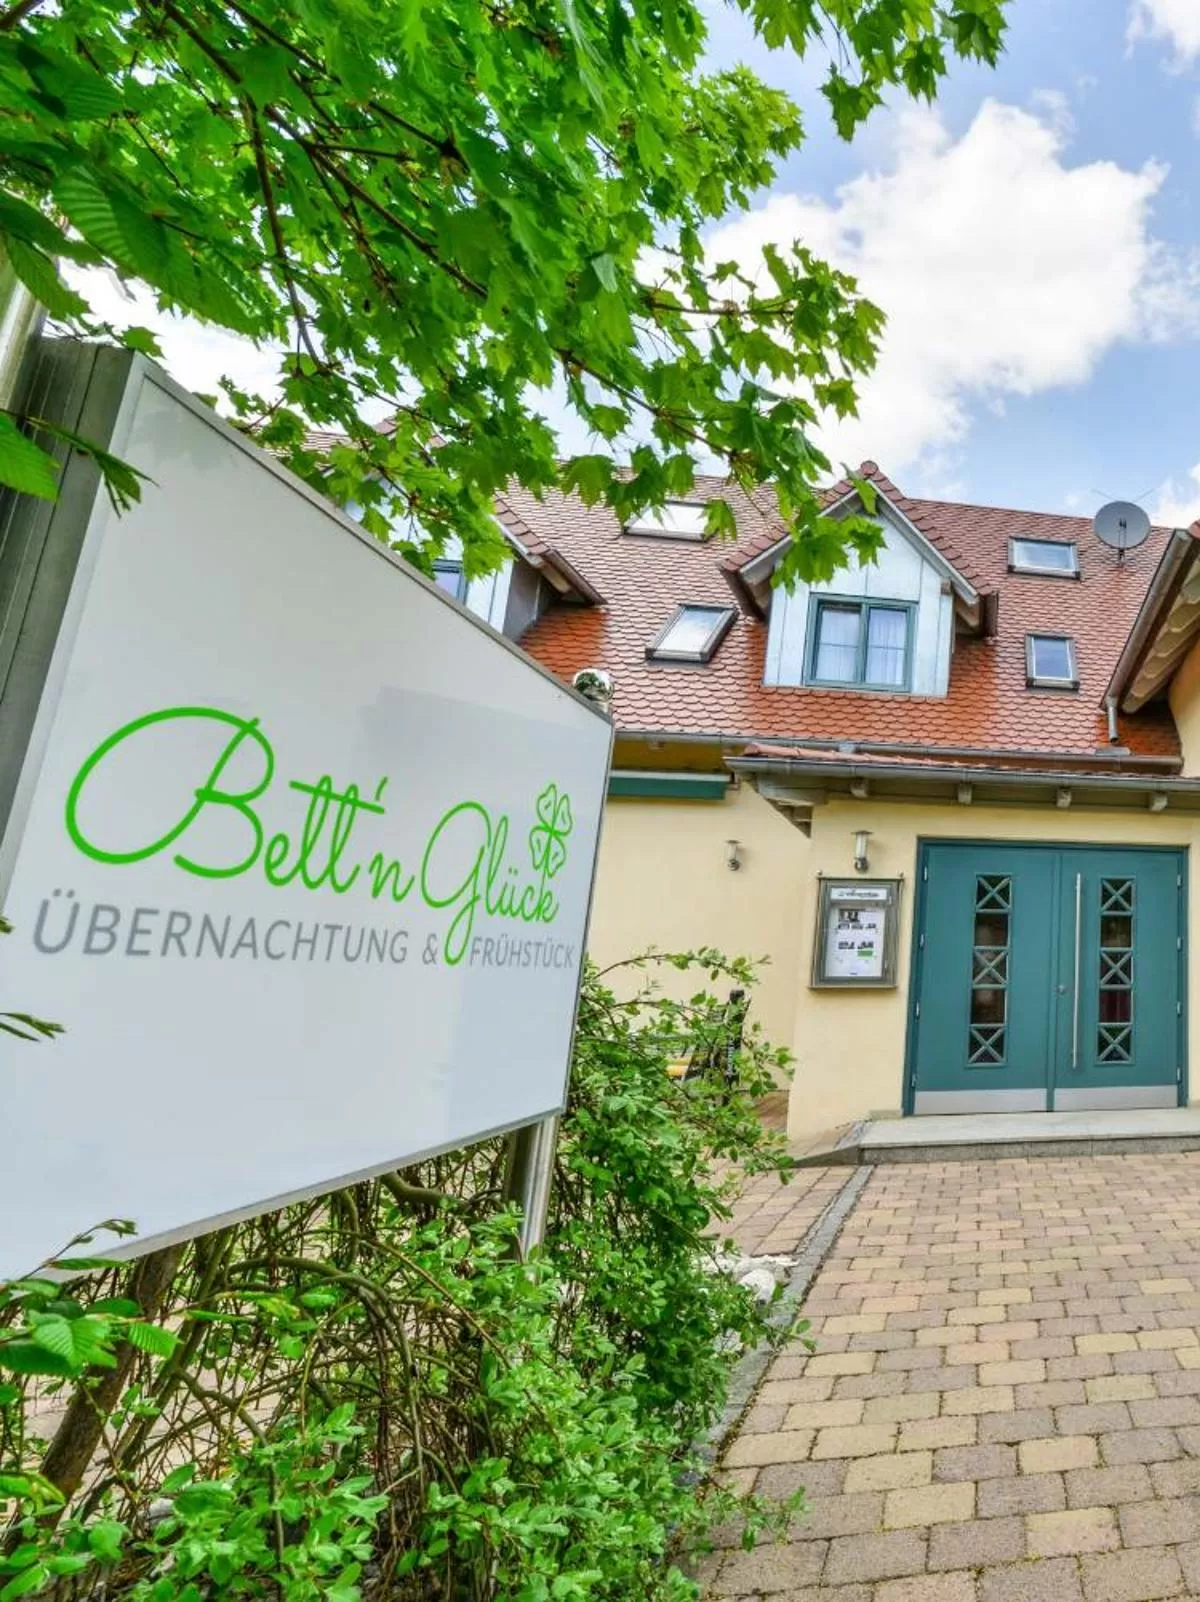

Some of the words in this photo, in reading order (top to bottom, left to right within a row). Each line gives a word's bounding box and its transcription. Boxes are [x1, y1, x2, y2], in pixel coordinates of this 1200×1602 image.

[32, 889, 409, 964] ÜBERNACHTUNG
[421, 934, 439, 965] &
[469, 935, 576, 970] FRÜHSTÜCK
[420, 800, 560, 966] Glück
